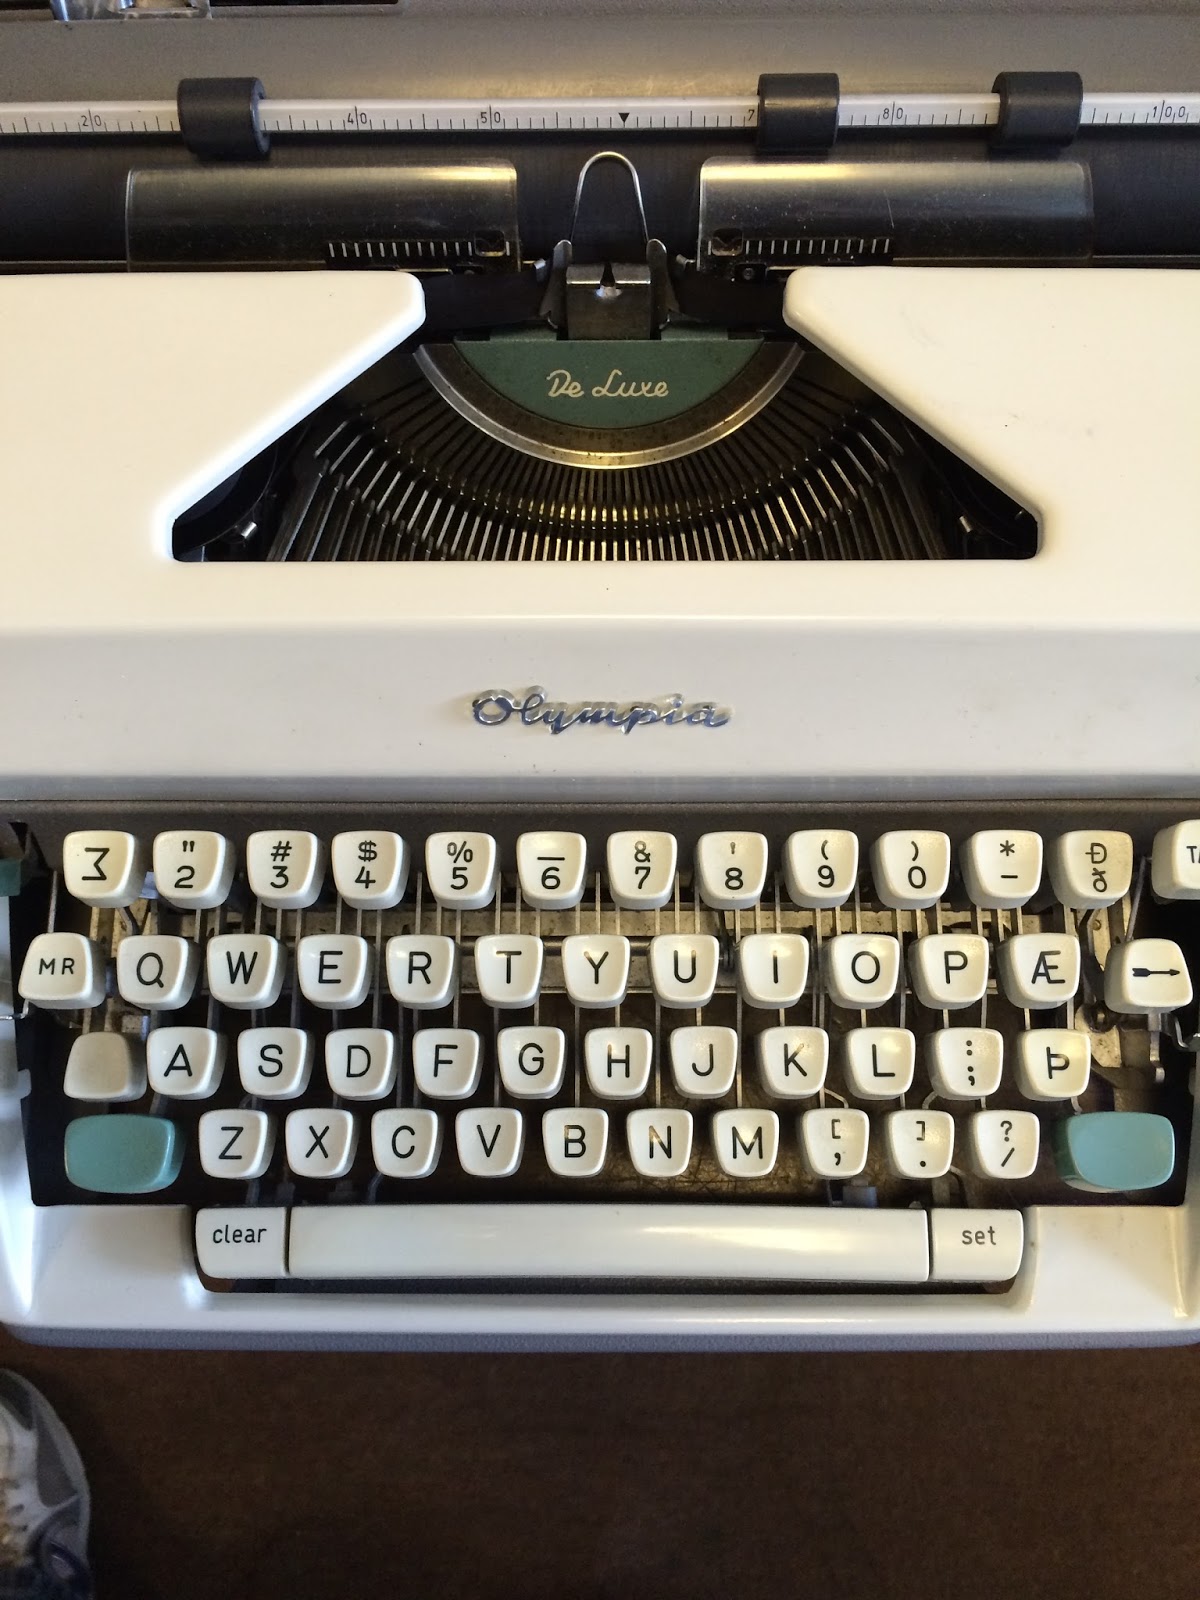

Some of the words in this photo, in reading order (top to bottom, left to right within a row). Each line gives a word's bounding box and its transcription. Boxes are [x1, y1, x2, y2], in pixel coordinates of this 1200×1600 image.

[81, 114, 102, 128] 20
[347, 112, 368, 125] 40
[480, 111, 501, 124] 50
[882, 107, 904, 120] 80
[547, 369, 584, 398] De
[592, 369, 669, 398] Luxe
[471, 685, 731, 734] Olympia
[174, 866, 195, 888] 2
[270, 866, 289, 888] 3
[355, 866, 376, 889] 4
[451, 867, 468, 890] 5
[541, 867, 560, 889] 6
[635, 866, 650, 889] 7
[725, 867, 743, 890] 8
[818, 865, 834, 888] 9
[39, 958, 74, 975] MR
[136, 952, 164, 988] Q
[226, 951, 258, 984] W
[318, 951, 343, 984] E
[408, 952, 432, 984] R
[497, 951, 522, 984] T
[586, 951, 609, 984] Y
[674, 950, 696, 983] U
[851, 951, 880, 984] O
[944, 951, 968, 984] P
[1031, 951, 1065, 984] Æ
[164, 1044, 193, 1077] A
[258, 1044, 283, 1077] S
[346, 1045, 371, 1077] D
[434, 1044, 458, 1077] F
[519, 1043, 544, 1076] G
[607, 1045, 630, 1078] H
[692, 1044, 714, 1076] J
[784, 1044, 807, 1077] K
[872, 1044, 895, 1077] L
[219, 1127, 244, 1160] Z
[306, 1126, 329, 1158] X
[392, 1125, 415, 1159] C
[477, 1125, 501, 1157] V
[565, 1125, 586, 1158] B
[649, 1126, 672, 1159] N
[732, 1126, 763, 1159] M
[213, 1225, 266, 1243] clear
[962, 1226, 996, 1245] set
